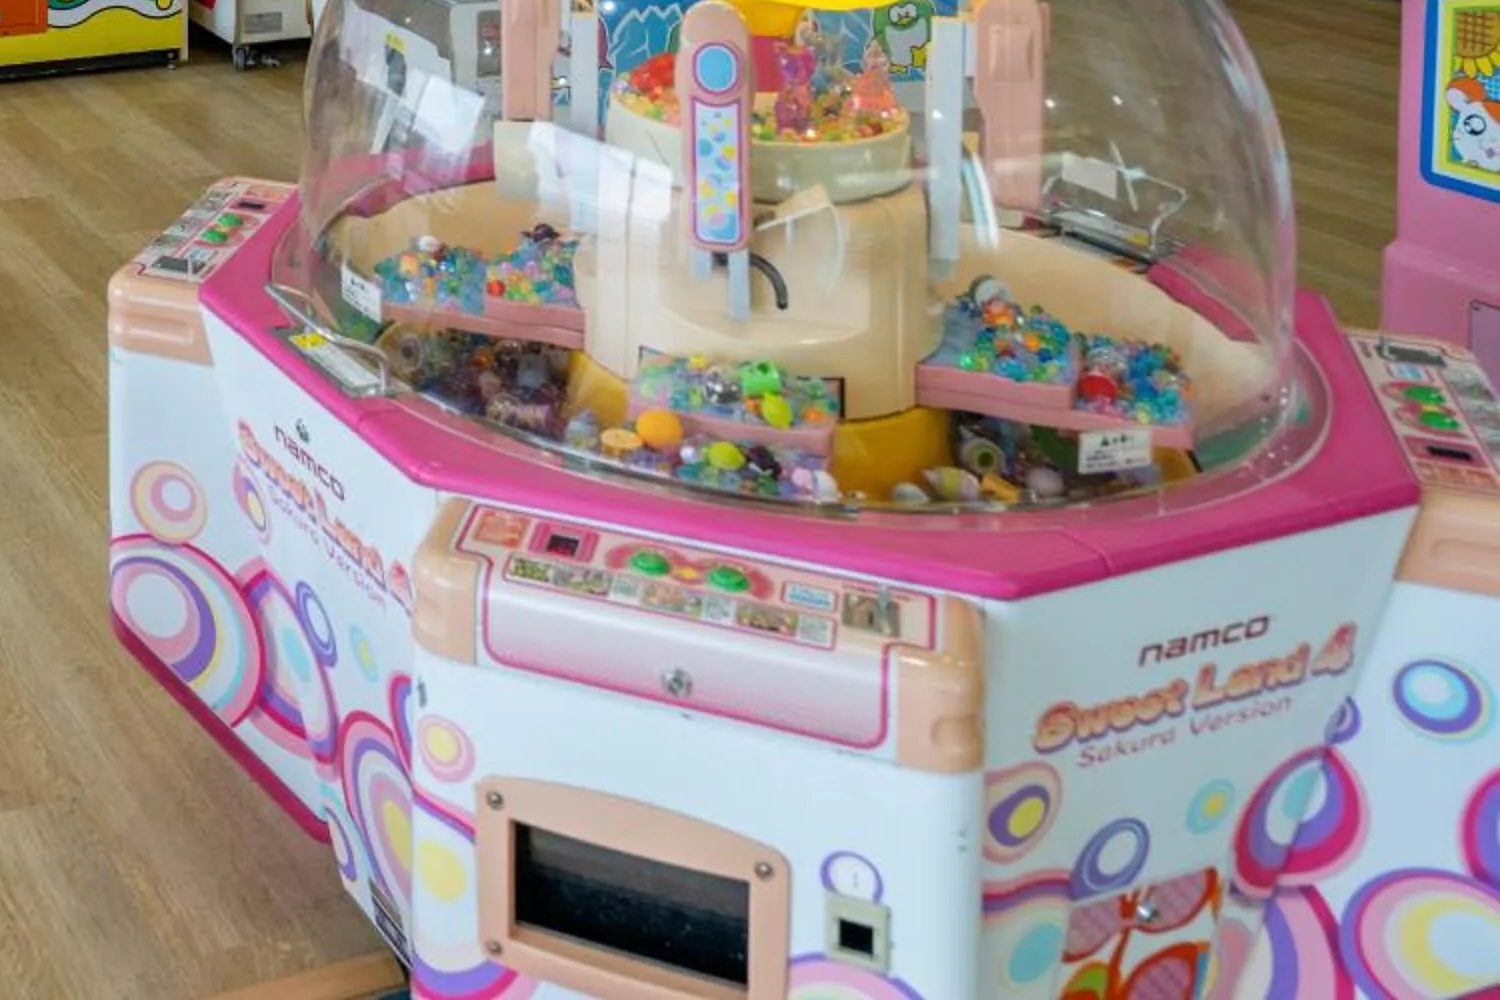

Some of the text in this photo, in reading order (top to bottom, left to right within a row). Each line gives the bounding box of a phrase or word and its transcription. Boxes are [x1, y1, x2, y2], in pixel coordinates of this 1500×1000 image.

[274, 424, 345, 501] namco
[1137, 614, 1272, 669] namco
[1032, 620, 1358, 755] Sweet Land 4
[1075, 695, 1295, 768] Sakura Version
